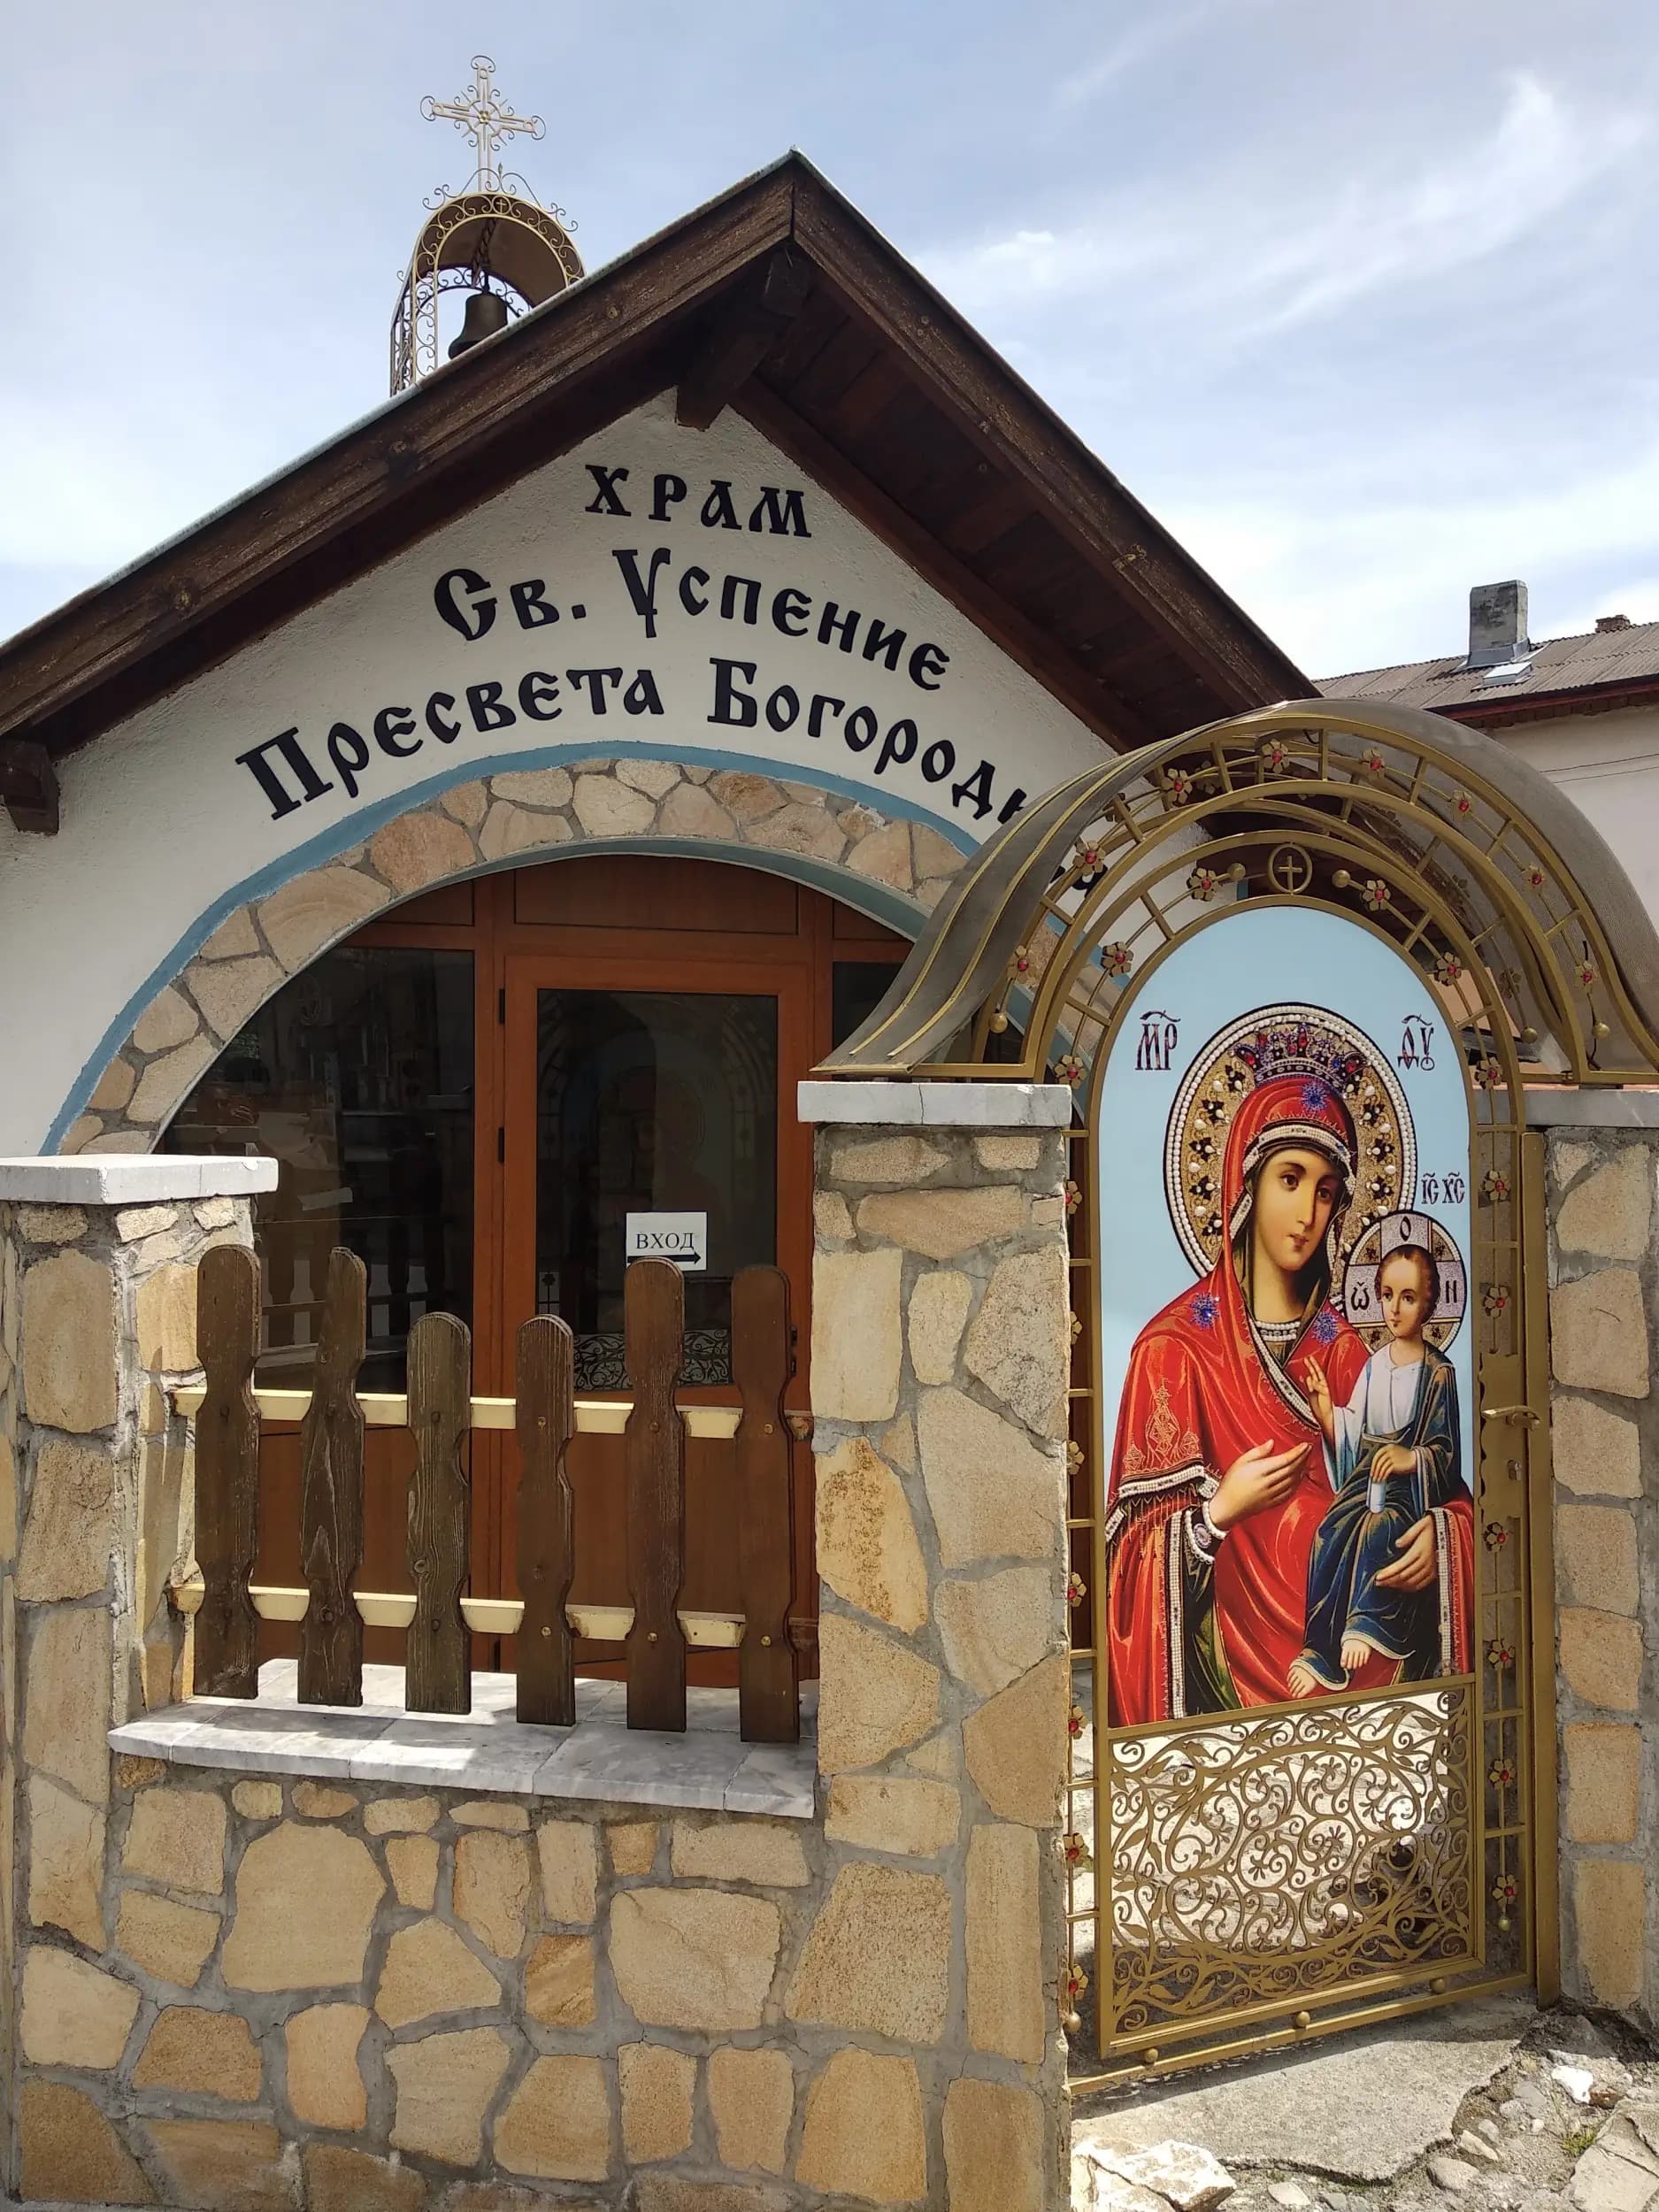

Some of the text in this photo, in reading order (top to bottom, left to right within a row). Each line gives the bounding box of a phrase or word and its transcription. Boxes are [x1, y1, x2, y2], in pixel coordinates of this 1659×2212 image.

[585, 464, 811, 538] ХРАМ
[235, 667, 664, 821] Пресвета
[635, 1233, 695, 1252] ВХОД
